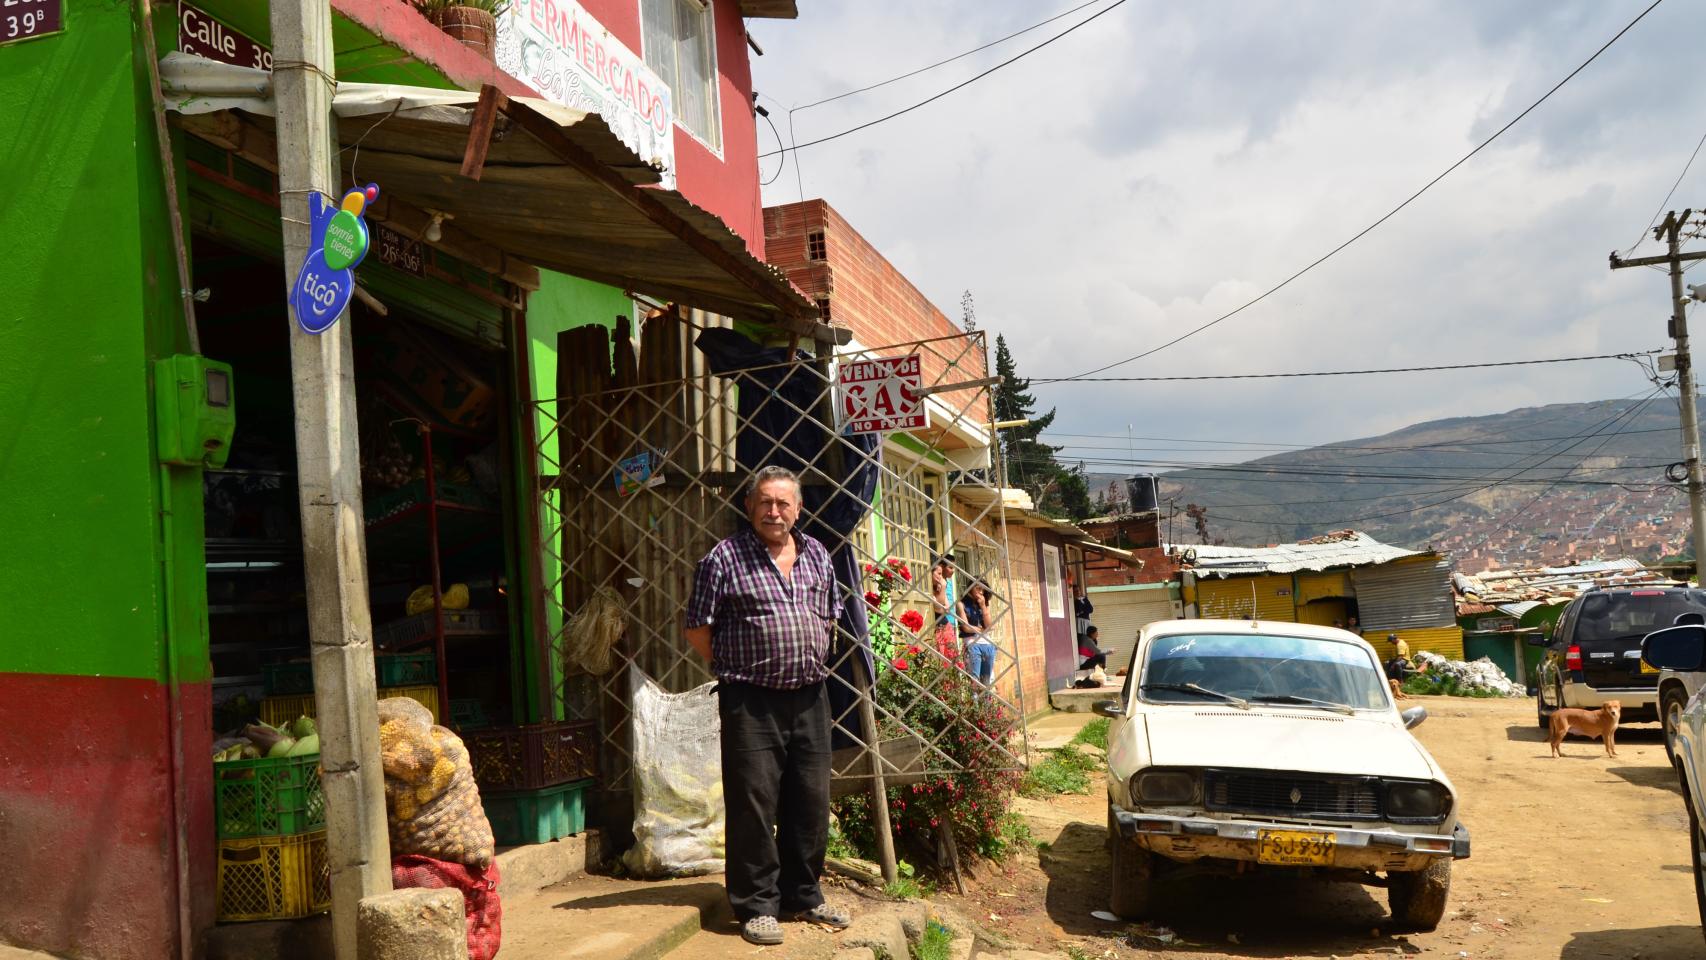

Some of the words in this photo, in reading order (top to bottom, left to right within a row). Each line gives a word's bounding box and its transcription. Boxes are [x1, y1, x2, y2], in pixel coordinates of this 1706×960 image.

[183, 9, 236, 57] Calle
[842, 361, 895, 381] VENTA
[900, 360, 918, 374] DE
[845, 379, 921, 420] GAS
[854, 421, 873, 431] NO
